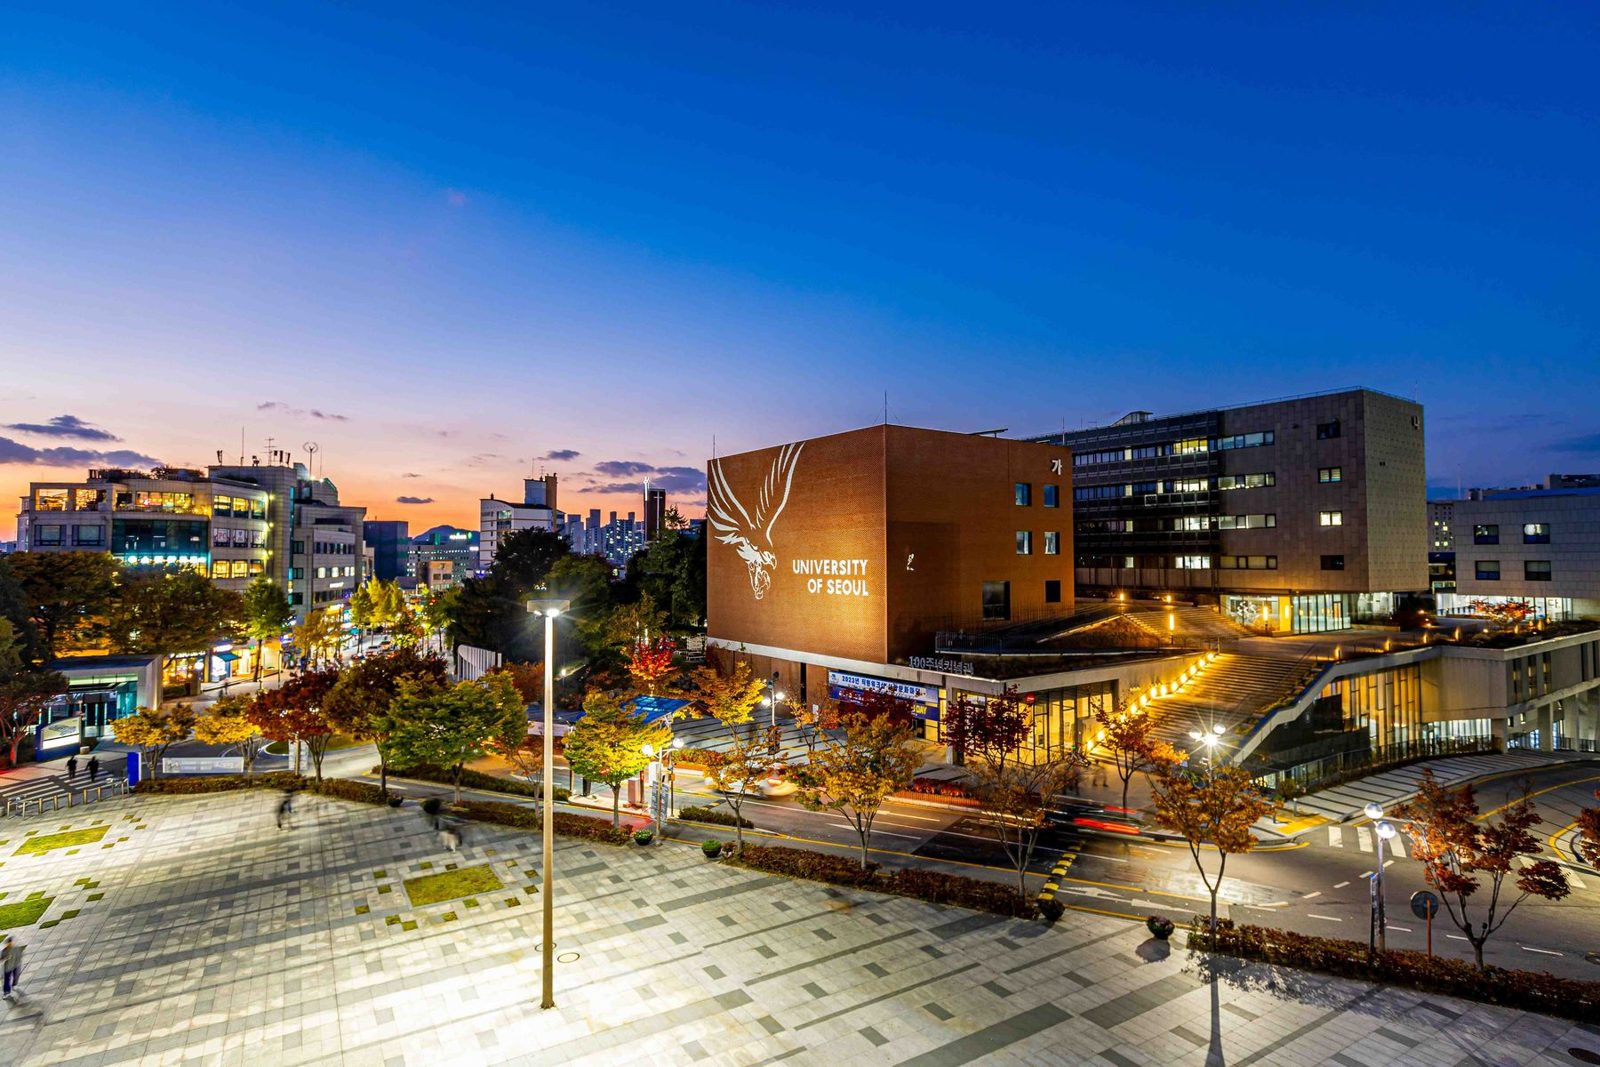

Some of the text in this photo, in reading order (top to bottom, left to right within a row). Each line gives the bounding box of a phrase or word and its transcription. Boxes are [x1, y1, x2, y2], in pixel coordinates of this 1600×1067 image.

[1052, 459, 1063, 475] 가
[792, 559, 868, 576] UNIVERSITY
[807, 578, 869, 597] OF SEOUL
[842, 675, 860, 685] 2023년
